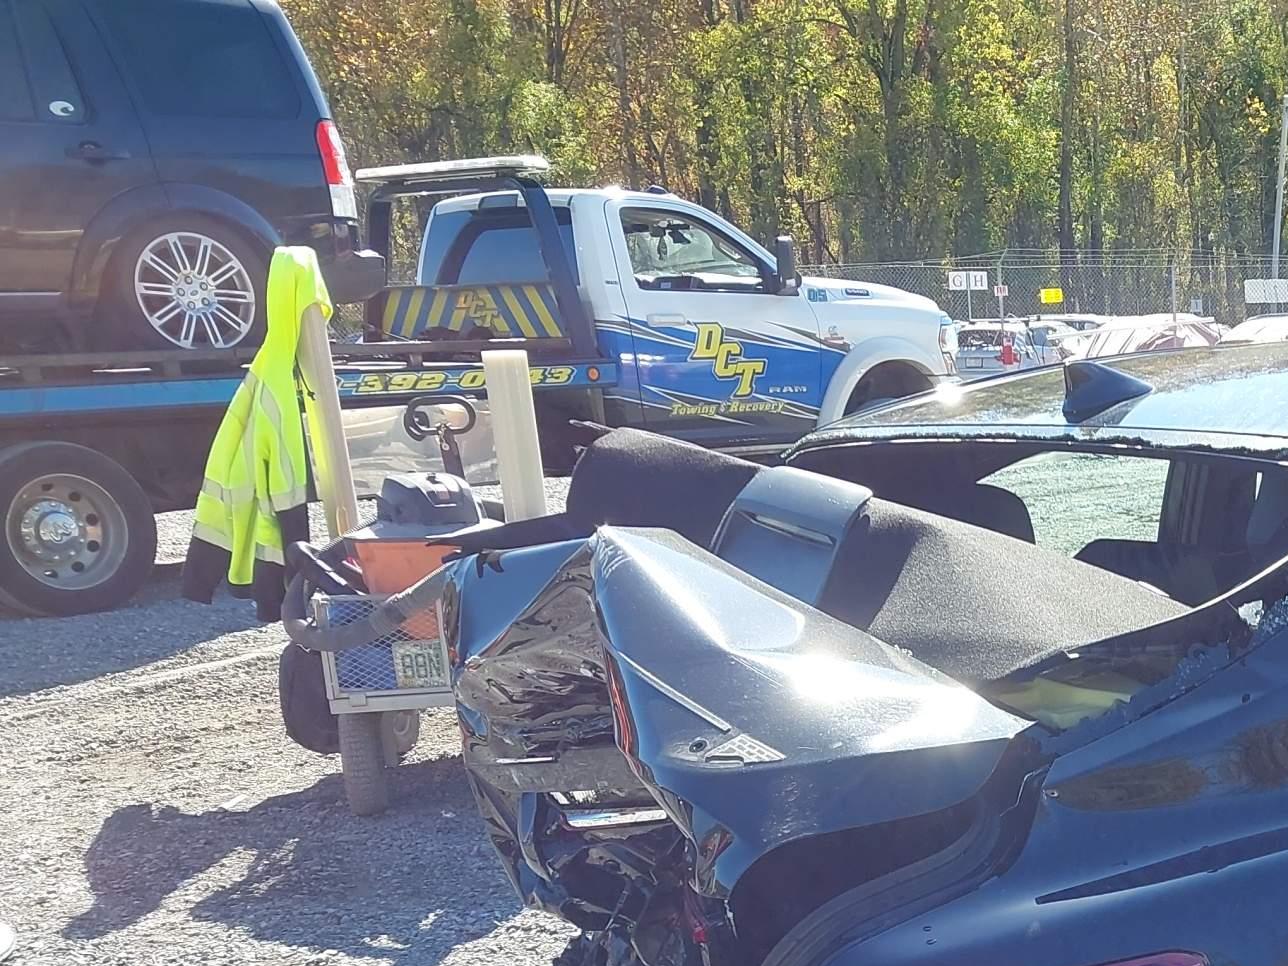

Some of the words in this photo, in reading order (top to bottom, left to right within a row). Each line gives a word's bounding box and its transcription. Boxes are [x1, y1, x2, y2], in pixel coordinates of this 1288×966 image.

[952, 274, 963, 288] G
[973, 274, 984, 288] H
[690, 322, 767, 397] DCT
[768, 385, 807, 394] RAM
[671, 402, 717, 416] Towing
[729, 400, 785, 414] Recovery
